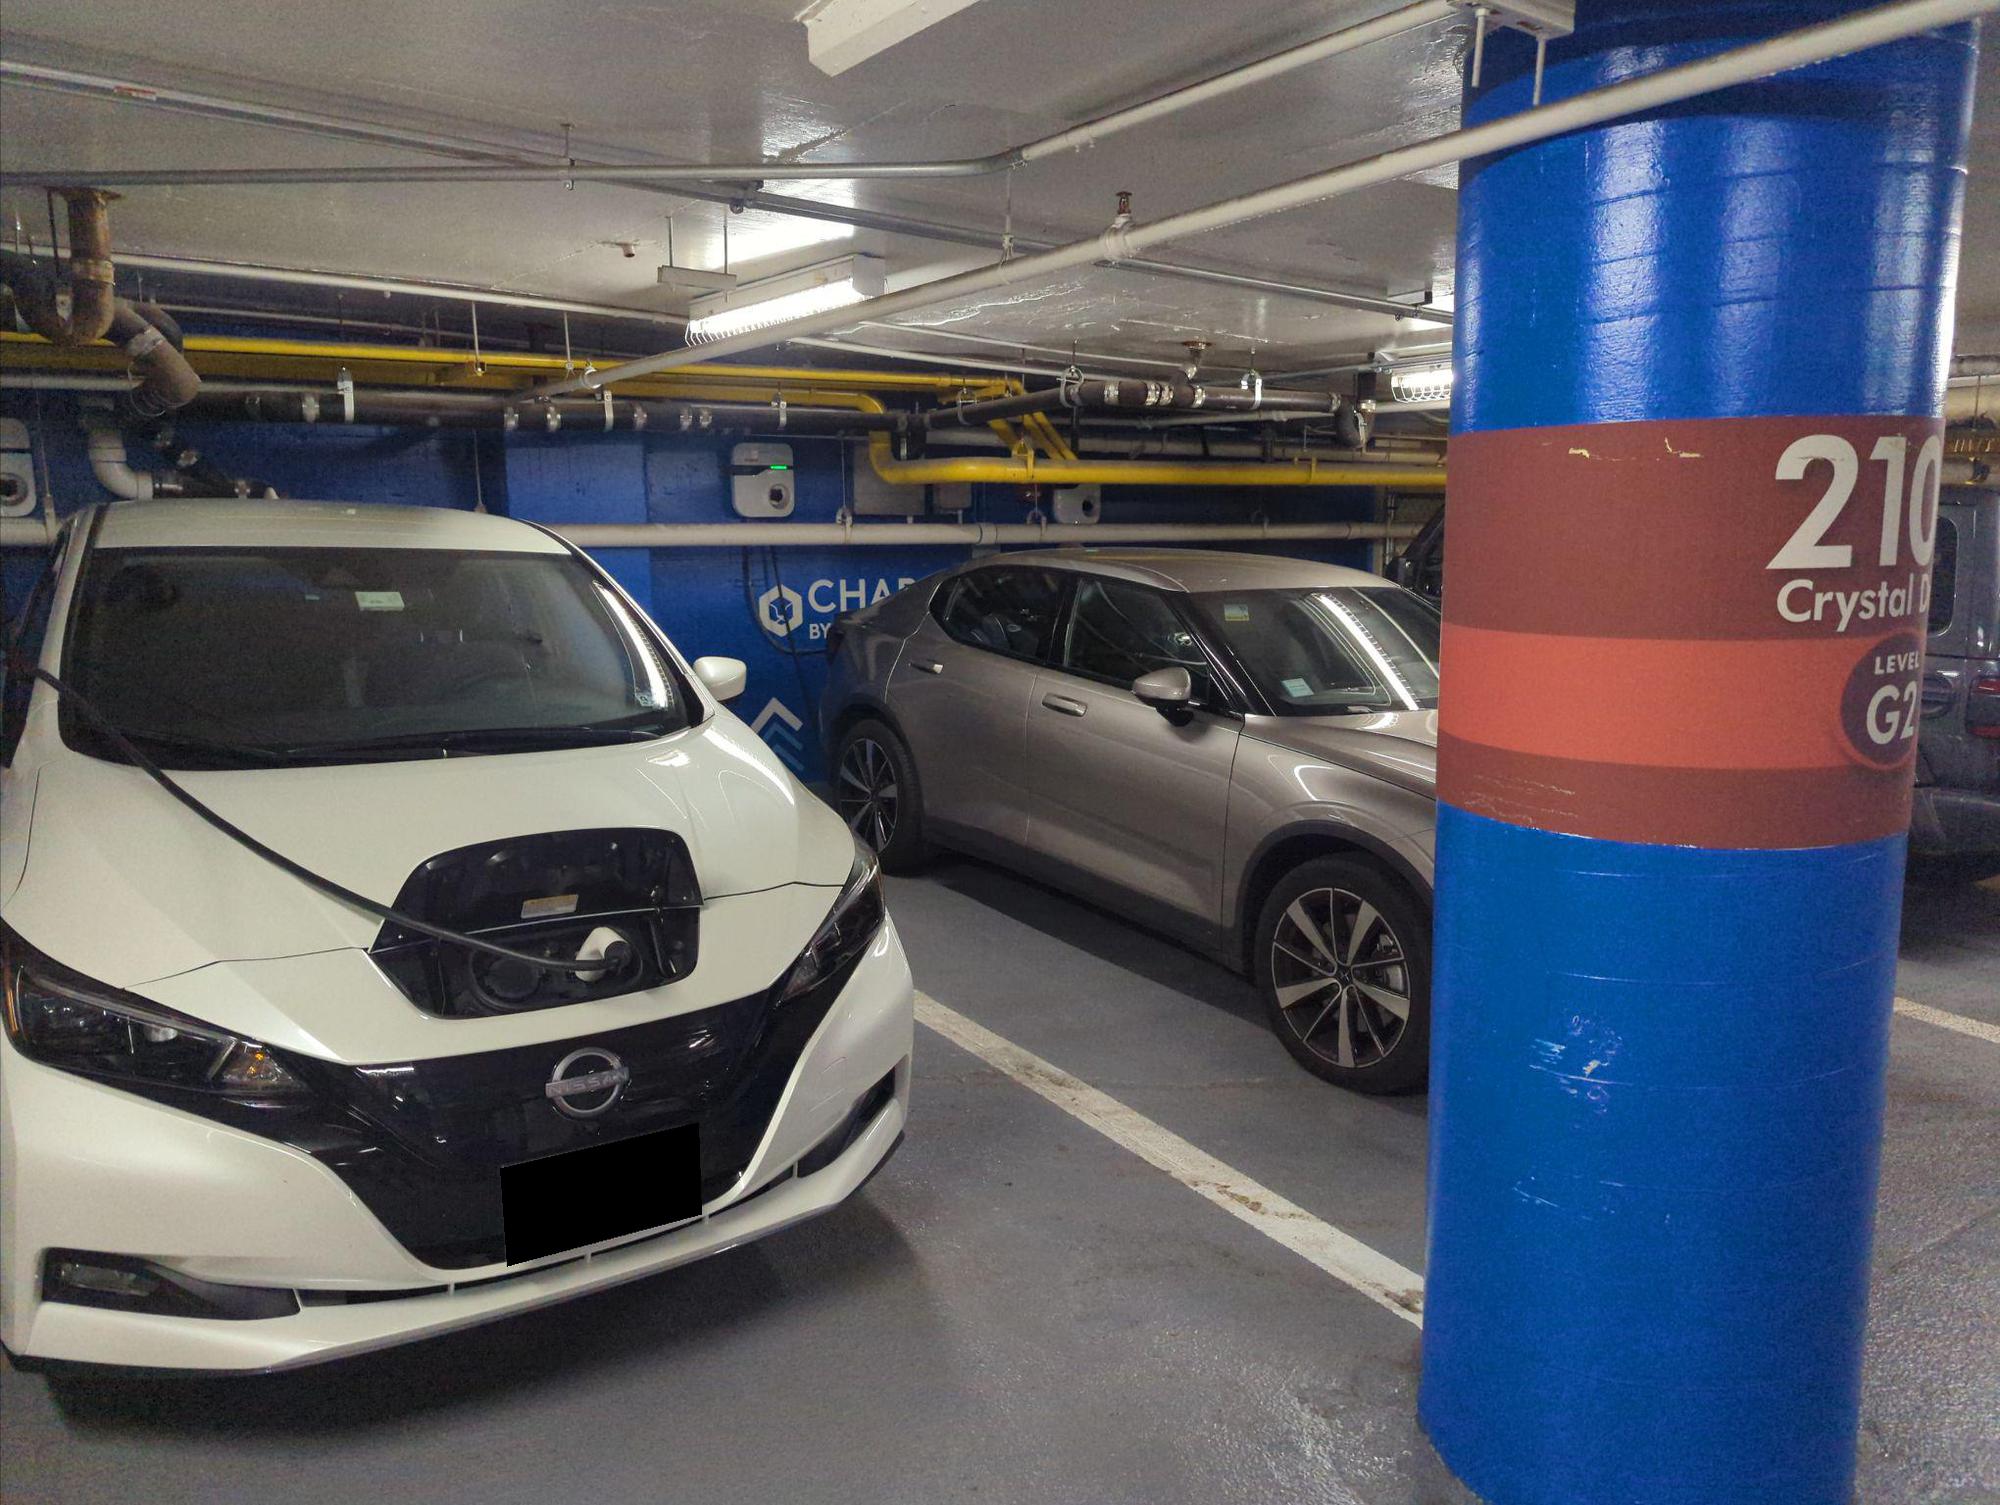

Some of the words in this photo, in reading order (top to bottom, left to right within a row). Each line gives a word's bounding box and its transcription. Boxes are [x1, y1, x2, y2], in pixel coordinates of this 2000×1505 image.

[1766, 433, 1941, 570] 210
[1776, 573, 1914, 633] Crystal
[809, 622, 831, 640] BY
[1874, 651, 1919, 675] LEVEL
[1866, 681, 1917, 745] G2
[547, 1070, 628, 1096] NISSAN
